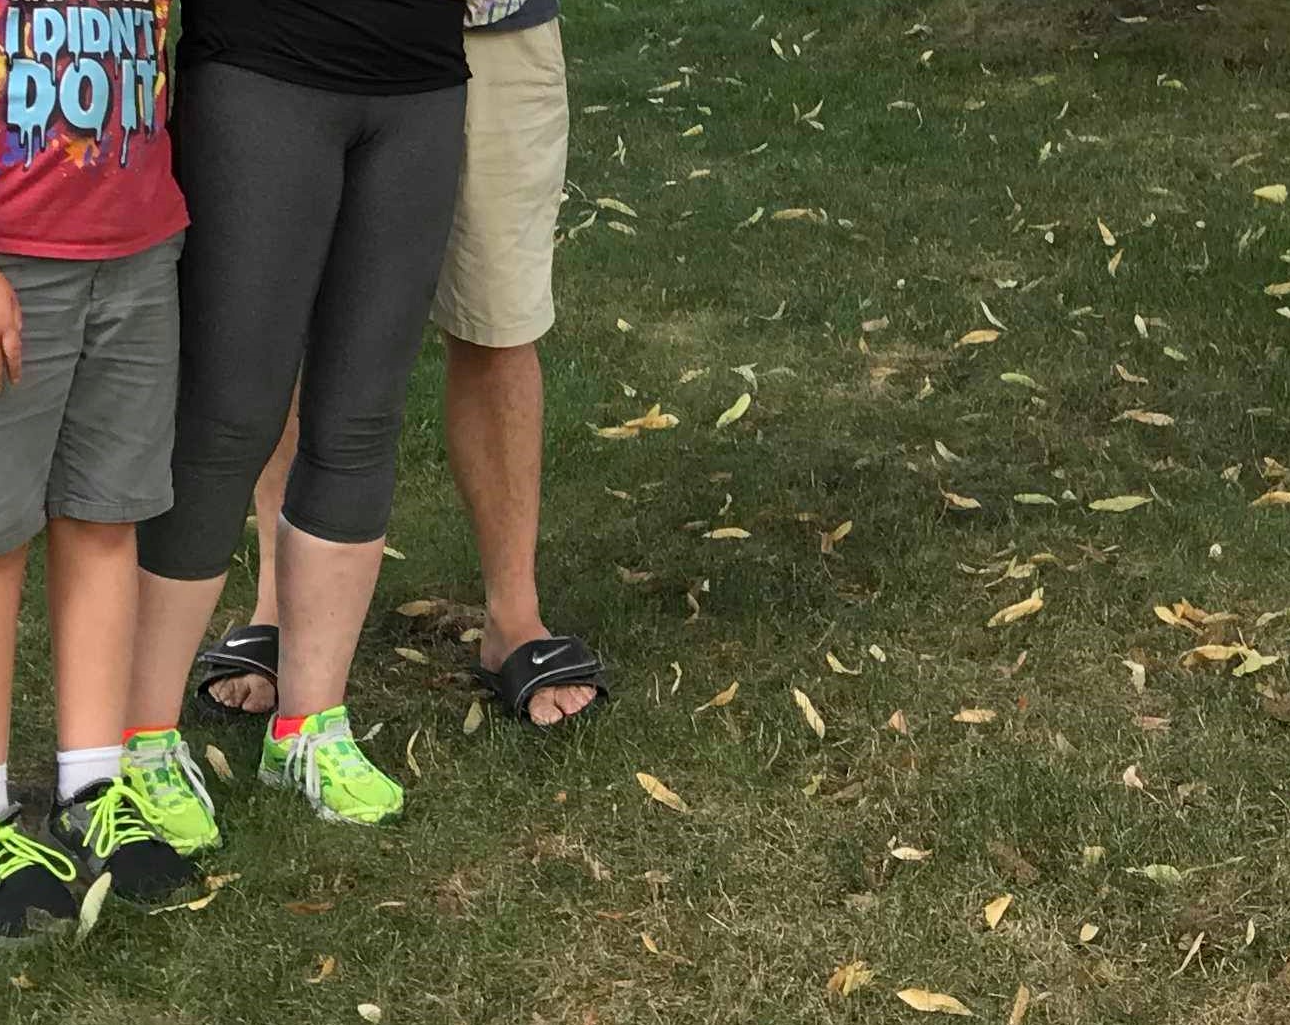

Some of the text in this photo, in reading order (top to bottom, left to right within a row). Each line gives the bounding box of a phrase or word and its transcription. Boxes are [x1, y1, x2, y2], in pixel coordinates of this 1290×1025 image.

[5, 6, 20, 61] I
[6, 58, 158, 145] DO IT
